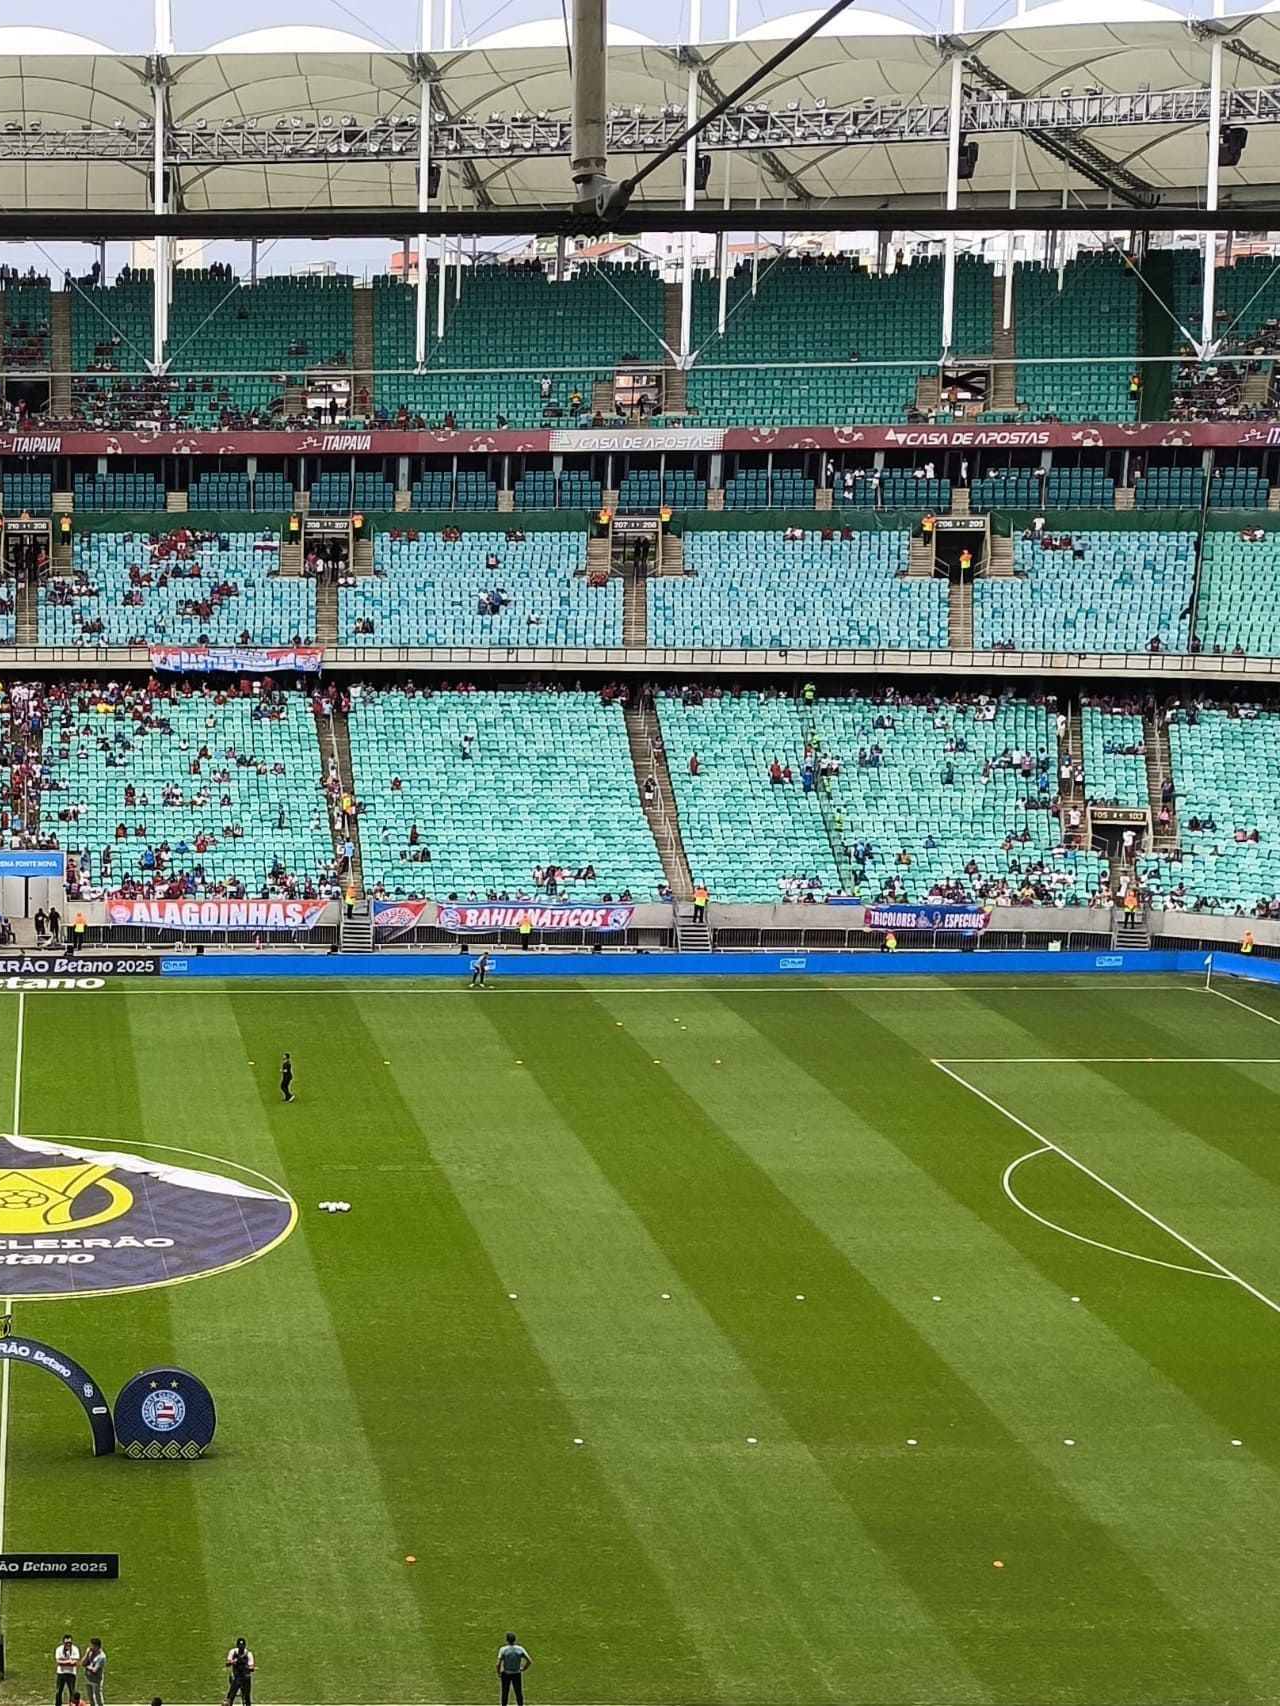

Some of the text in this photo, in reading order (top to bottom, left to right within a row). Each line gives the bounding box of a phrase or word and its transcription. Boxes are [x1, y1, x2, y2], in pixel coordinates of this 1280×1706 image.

[12, 437, 61, 452] ITAIPAVA
[322, 435, 371, 451] ITAIPAVA
[579, 436, 713, 449] CASA DE APOSTAS
[906, 432, 1049, 445] CASA DE APOSTAS
[15, 860, 37, 868] FONTE
[38, 860, 58, 868] NOVA
[132, 902, 304, 927] ALAGOINHAS
[870, 910, 985, 929] TRICOLORES ESPECIAIS
[53, 958, 114, 973] Betano
[116, 960, 155, 973] 2025
[33, 1350, 71, 1378] Betano
[22, 1561, 68, 1573] Betano
[70, 1562, 108, 1573] 2025
